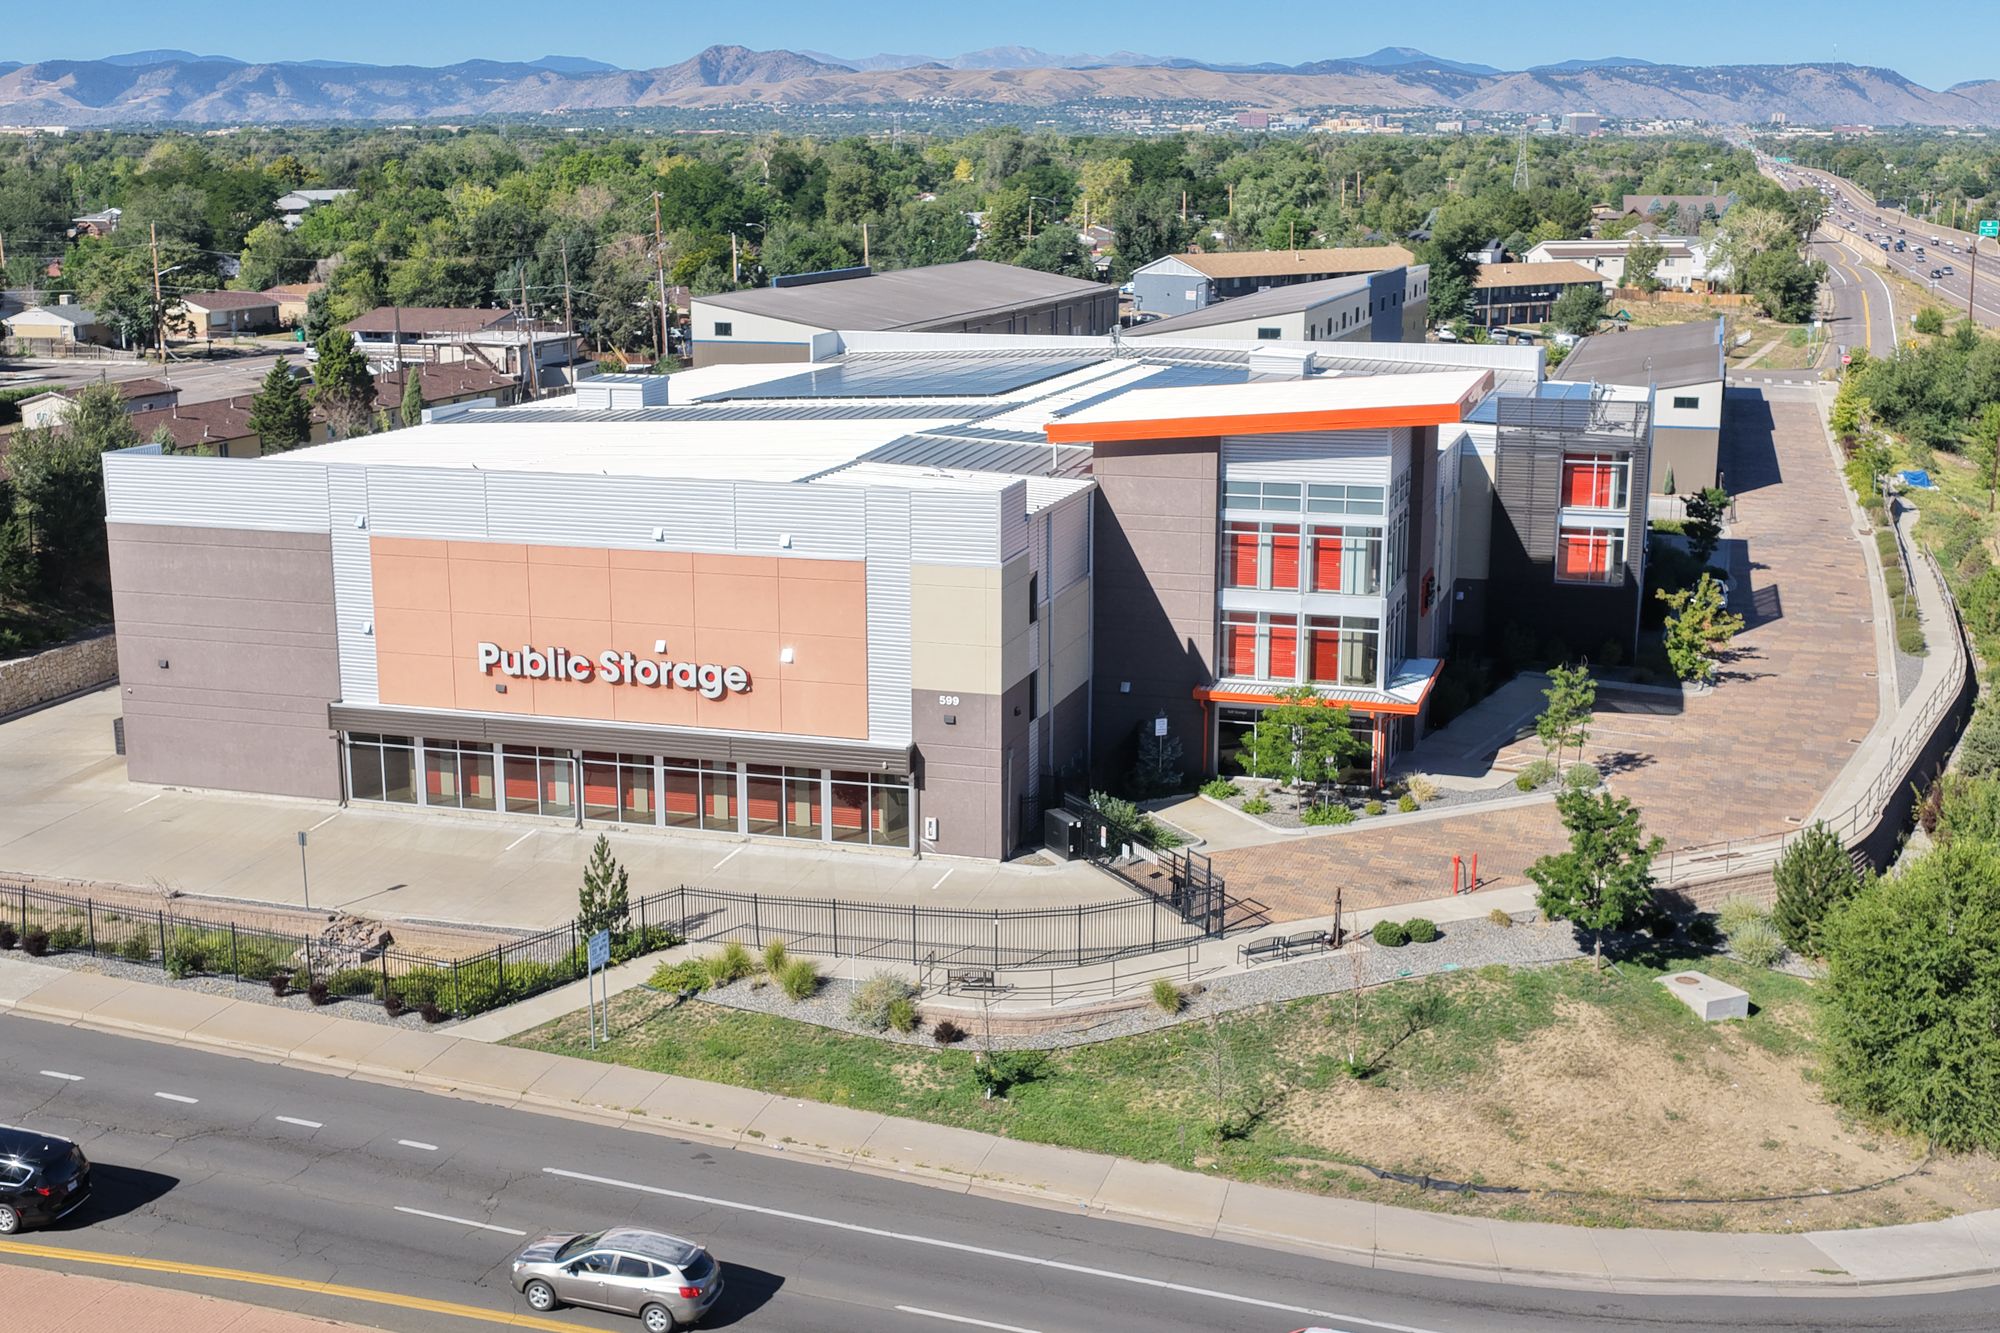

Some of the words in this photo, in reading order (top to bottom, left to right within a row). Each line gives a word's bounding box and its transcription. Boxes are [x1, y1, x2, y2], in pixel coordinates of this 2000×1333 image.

[478, 641, 590, 681] Public
[599, 649, 748, 699] Storage
[939, 695, 960, 706] 599
